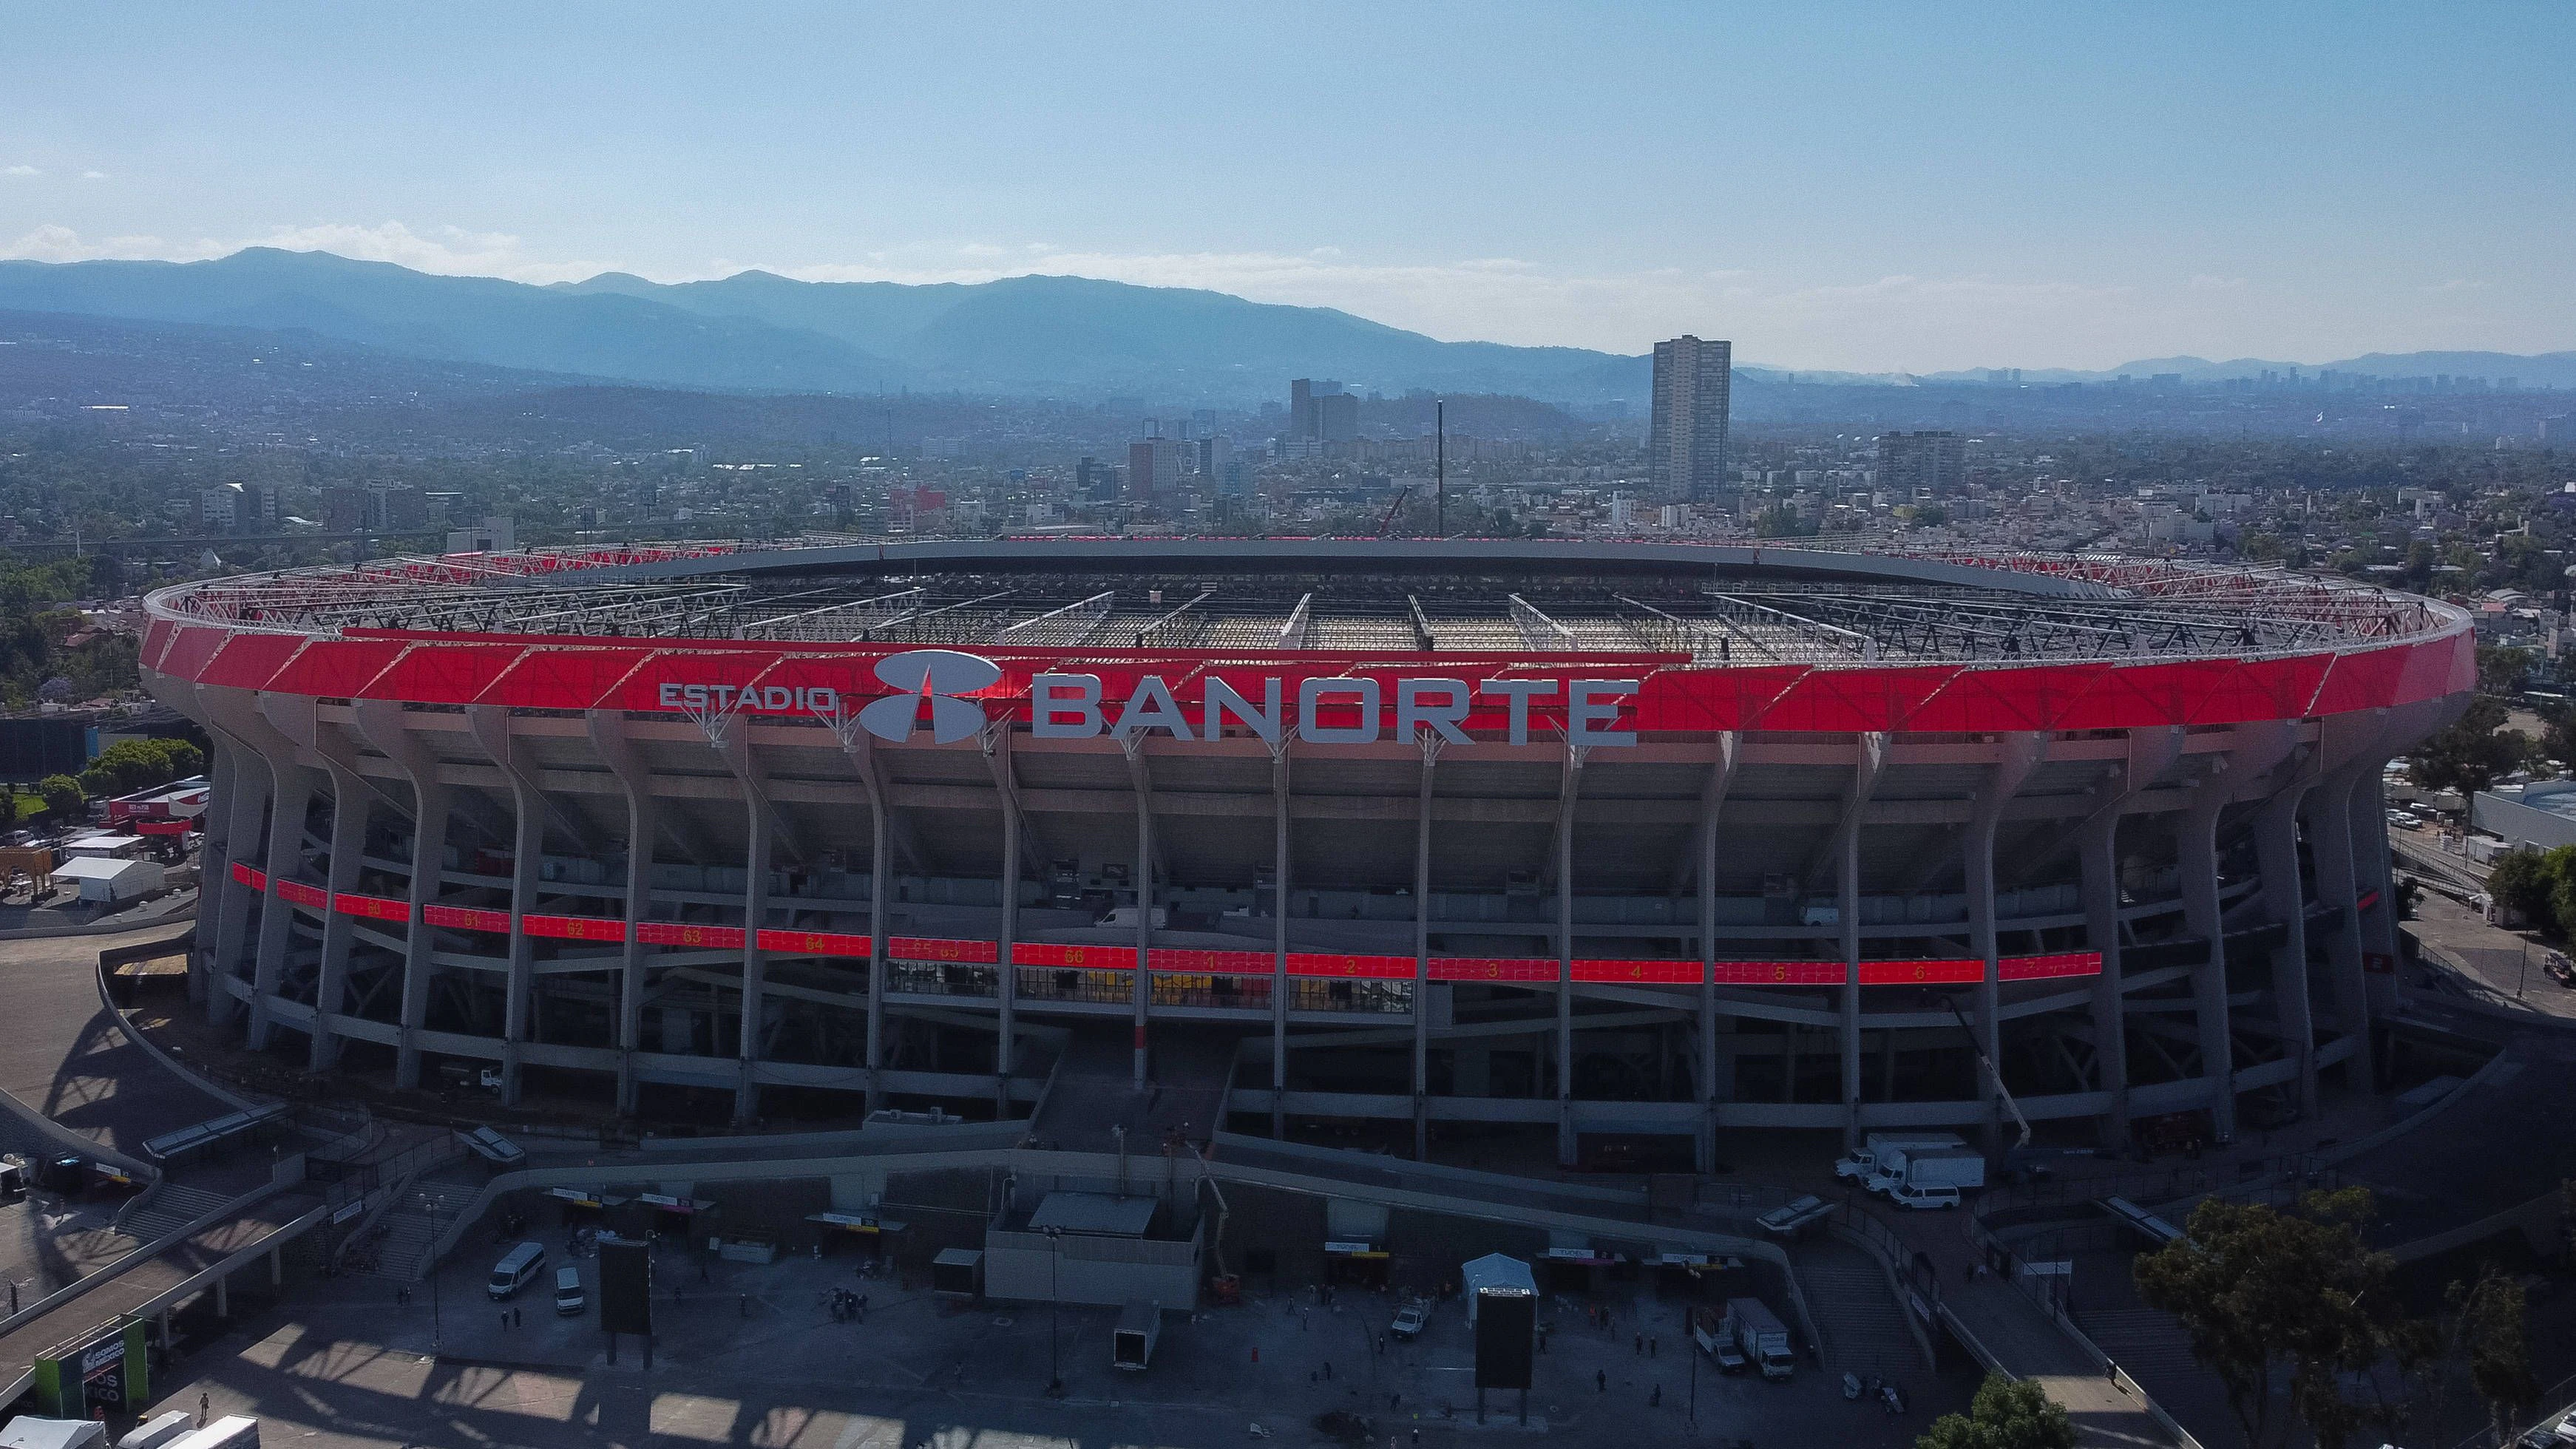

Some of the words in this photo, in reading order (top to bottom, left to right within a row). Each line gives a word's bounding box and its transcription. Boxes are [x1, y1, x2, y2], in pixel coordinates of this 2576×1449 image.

[660, 683, 838, 711] ESTADIO
[1032, 673, 1639, 747] BANORTE
[567, 923, 583, 936] 62
[683, 930, 701, 946] 63
[806, 937, 824, 951] 64
[1207, 955, 1215, 968] 1
[1347, 960, 1356, 974] 2
[1488, 963, 1499, 977] 3
[1632, 965, 1641, 978] 4
[1775, 966, 1785, 980] 5
[1916, 967, 1925, 979] 6
